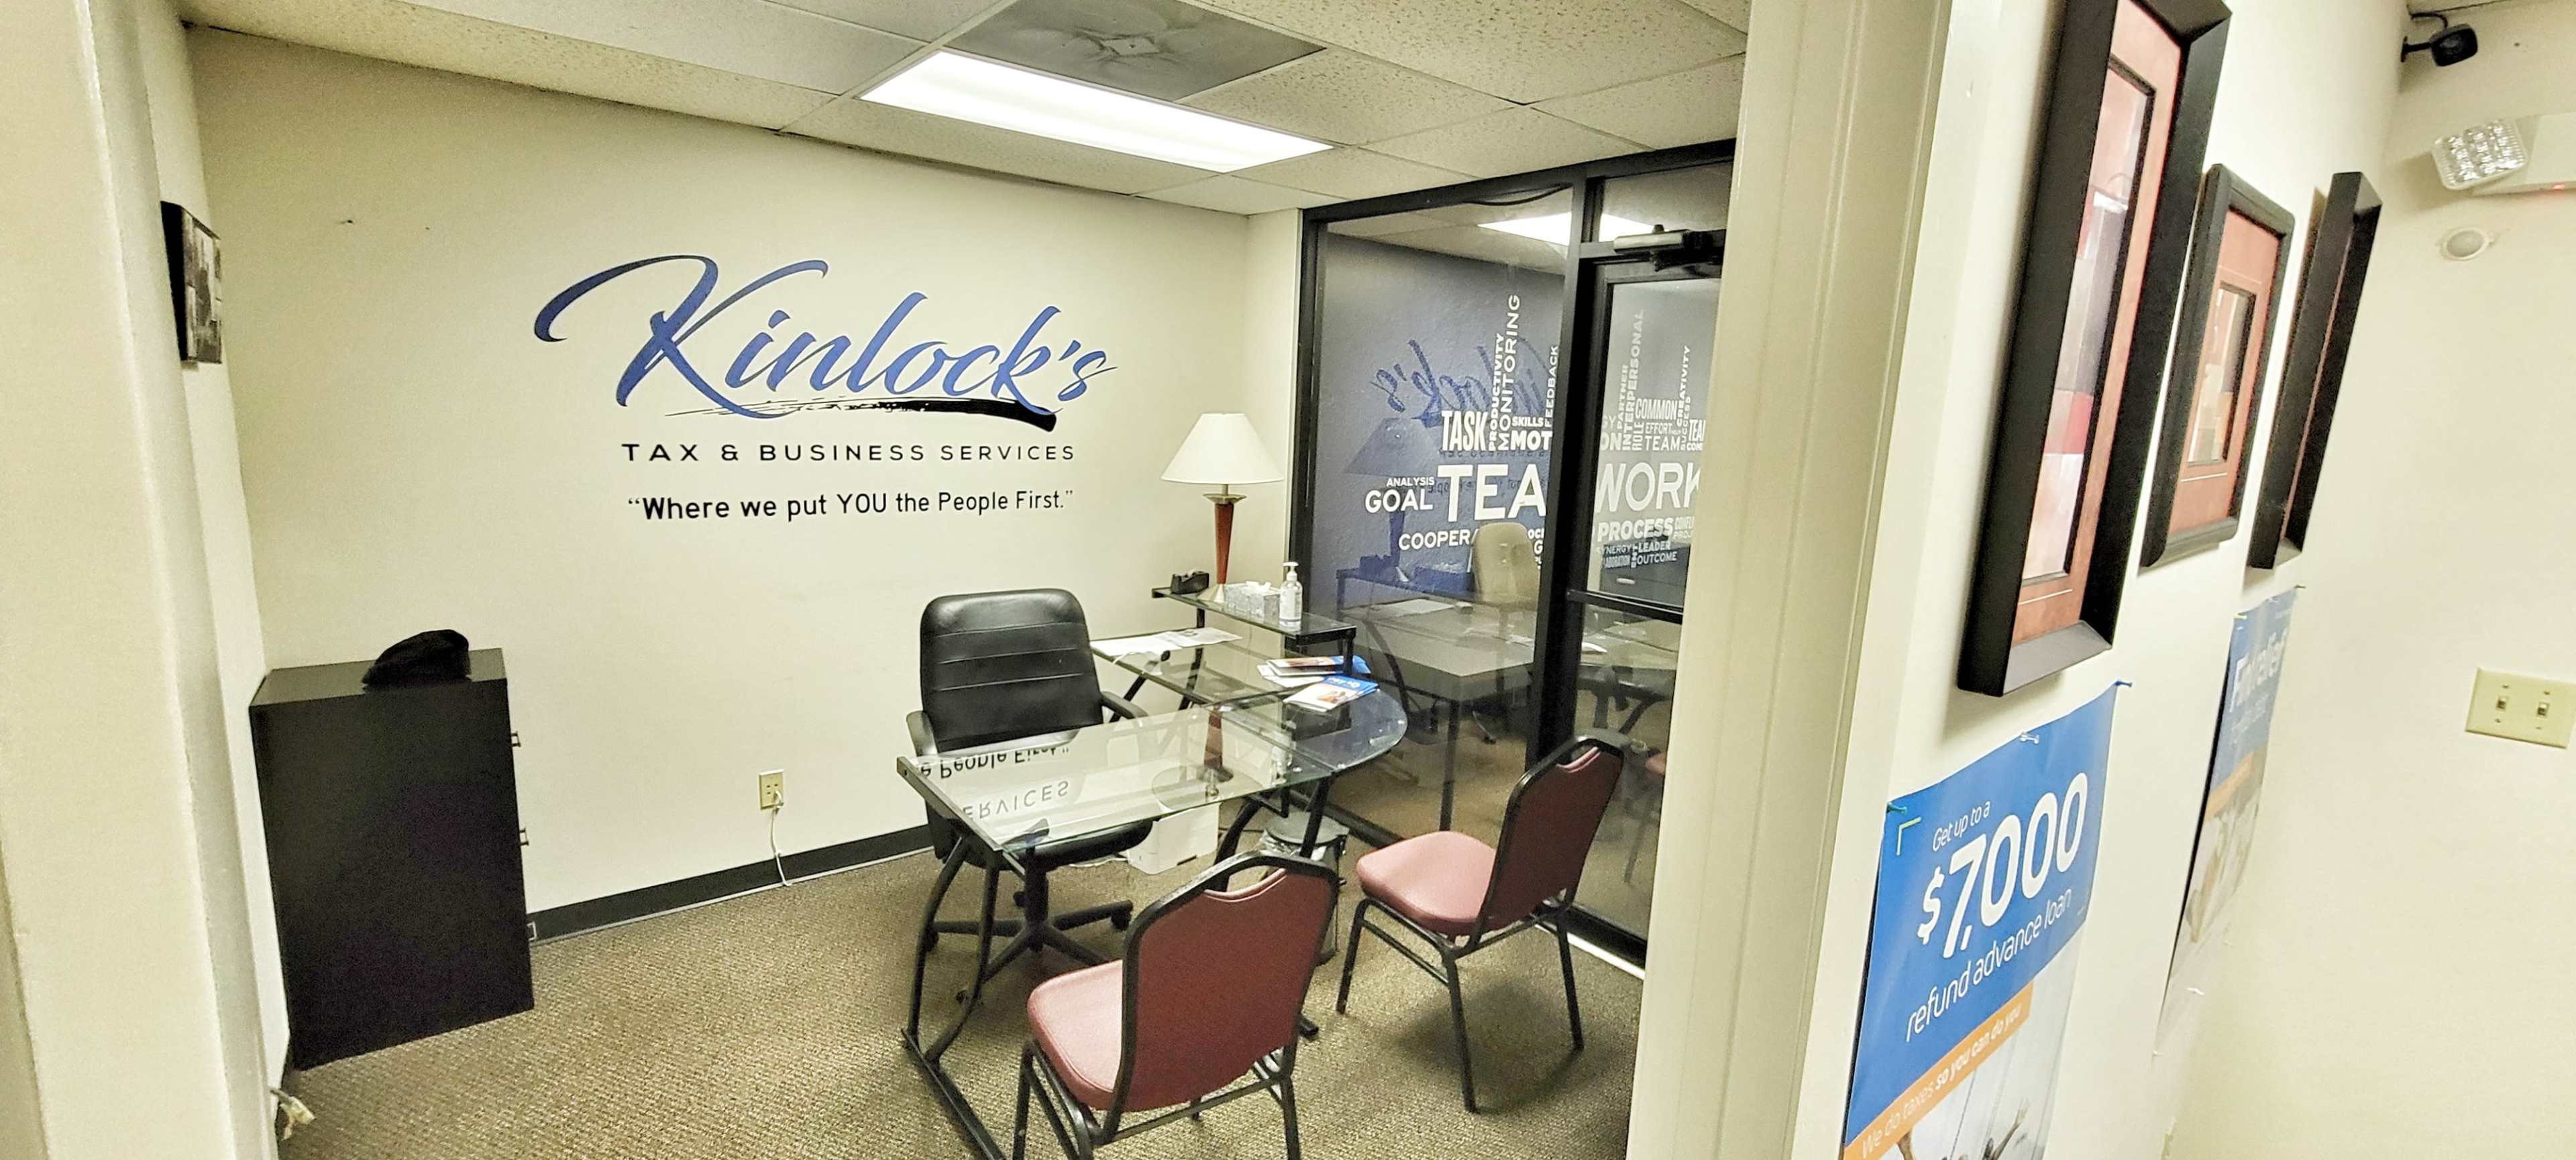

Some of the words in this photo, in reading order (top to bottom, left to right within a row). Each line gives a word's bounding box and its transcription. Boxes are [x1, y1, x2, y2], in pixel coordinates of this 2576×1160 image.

[534, 255, 1118, 419] Kinlock's
[1497, 295, 1521, 451] MONITORING
[1544, 346, 1558, 427] FEEDBACK
[1622, 310, 1643, 451] INTERPERSONAL
[1676, 345, 1690, 427] CREATIVITY
[1489, 333, 1504, 451] PRODUCTIVITY
[1617, 364, 1628, 429] PARTNER
[1511, 416, 1544, 427] SKILLS
[1635, 398, 1678, 421] COMMON
[1442, 410, 1488, 451] TASK
[1510, 430, 1553, 451] MOT
[1631, 421, 1644, 451] ROLE
[1644, 435, 1681, 451] TEAM
[1645, 422, 1673, 435] EFFORT
[1688, 419, 1707, 442] TEA
[622, 443, 698, 462] TAX
[721, 444, 739, 462] &
[759, 444, 924, 462] BUSINESS
[941, 445, 1074, 461] SERVICES
[1386, 476, 1435, 488] ANALYSIS
[1437, 464, 1547, 523] TEA
[740, 500, 777, 517] we
[787, 494, 827, 522] put
[837, 493, 887, 514] YOU
[896, 493, 930, 513] the
[938, 491, 1009, 516] People
[1364, 488, 1434, 513] GOAL
[1398, 528, 1480, 551] COOPER
[1597, 517, 1674, 543] PROCESS
[1637, 551, 1678, 565] OUTCOME
[1638, 539, 1671, 553] LEADER
[1932, 821, 1953, 852] Get
[1953, 812, 1970, 838] up
[1970, 804, 1984, 827] to
[1983, 800, 1991, 818] a
[1917, 772, 2088, 959] $7,000
[1905, 960, 1972, 1043] refund
[1973, 914, 2042, 986] advance
[2044, 888, 2072, 930] loan
[1862, 1129, 1882, 1159] We
[1884, 1112, 1900, 1137] do
[1902, 1081, 1935, 1120] taxes
[1935, 1068, 1949, 1090] so
[1949, 1047, 1971, 1082] you
[1971, 1032, 1991, 1058] can
[1990, 1018, 2004, 1040] do
[2004, 1003, 2022, 1031] you
